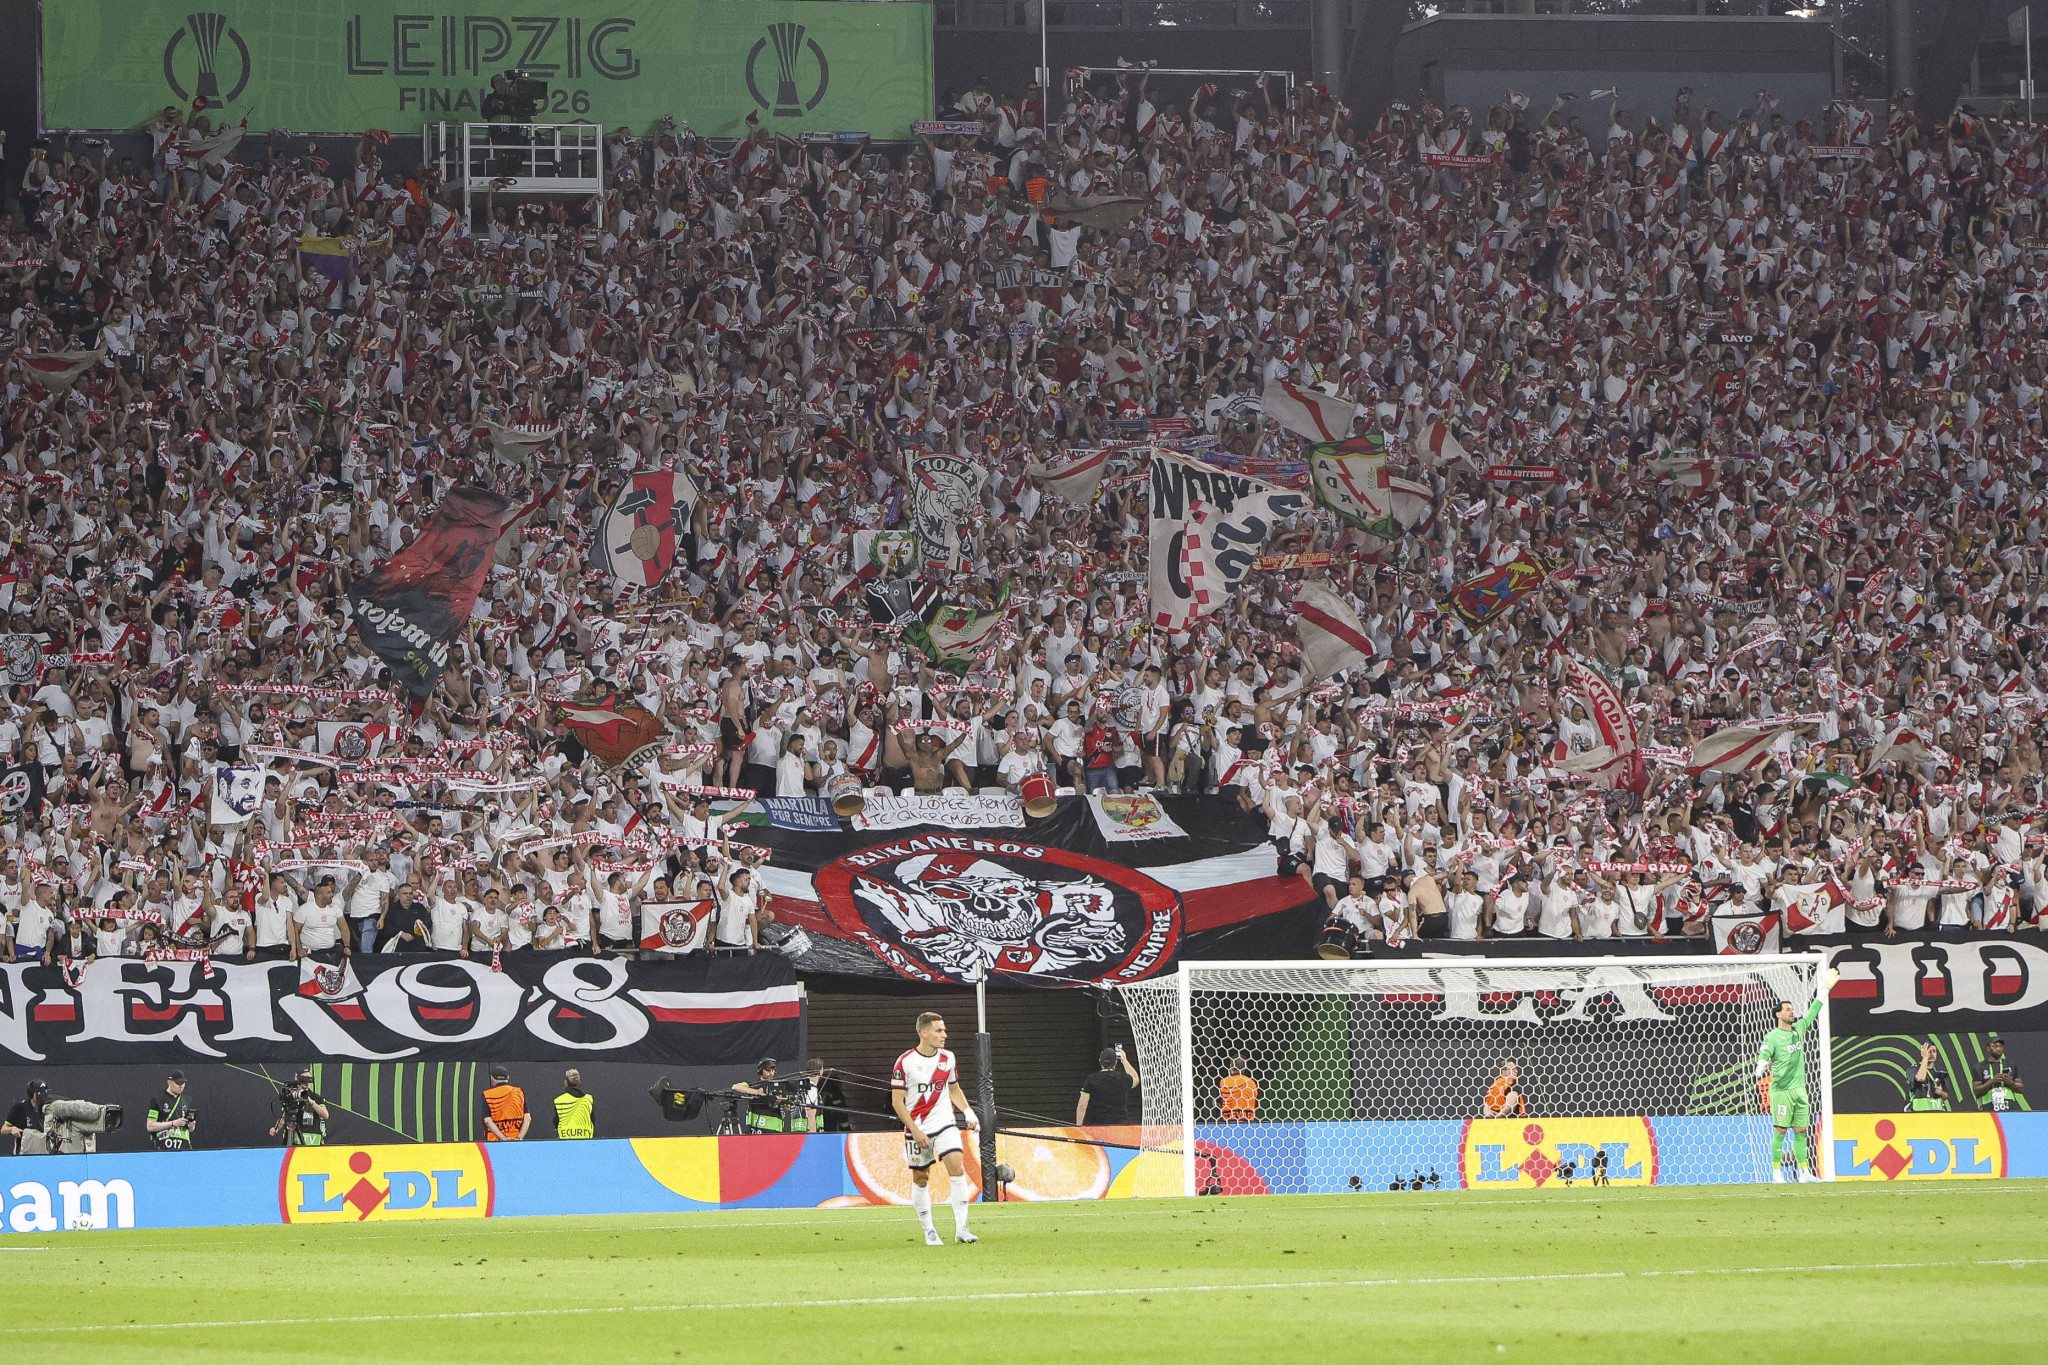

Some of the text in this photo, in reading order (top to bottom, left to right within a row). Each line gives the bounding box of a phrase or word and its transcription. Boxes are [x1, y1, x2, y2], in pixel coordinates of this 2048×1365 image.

[346, 14, 641, 81] LEIPZIG
[1721, 334, 1753, 342] RAYO
[272, 684, 309, 693] RAYO
[676, 743, 714, 753] RAYO
[370, 757, 400, 766] PUTO
[353, 772, 382, 782] PUTO
[664, 783, 756, 799] EL PUTO RAYO
[766, 797, 830, 815] MARTOLA
[771, 810, 833, 827] POR SEMPRE
[869, 813, 890, 825] TE
[896, 810, 981, 825] QUEREMOS
[846, 835, 1045, 867] BUKANEROS
[1588, 862, 1688, 873] EL PUTO RAYO
[1942, 880, 1978, 890] RAYO
[1821, 897, 1828, 906] D
[80, 907, 108, 918] PUTO
[124, 909, 161, 922] RAYO
[1118, 907, 1172, 979] SIEMPRE
[1777, 1104, 1788, 1116] 13
[164, 1138, 183, 1150] 017
[909, 1141, 921, 1155] 19
[1834, 1119, 1992, 1181] LIDL
[1476, 1124, 1643, 1187] LIDL
[297, 1152, 477, 1221] LIDL
